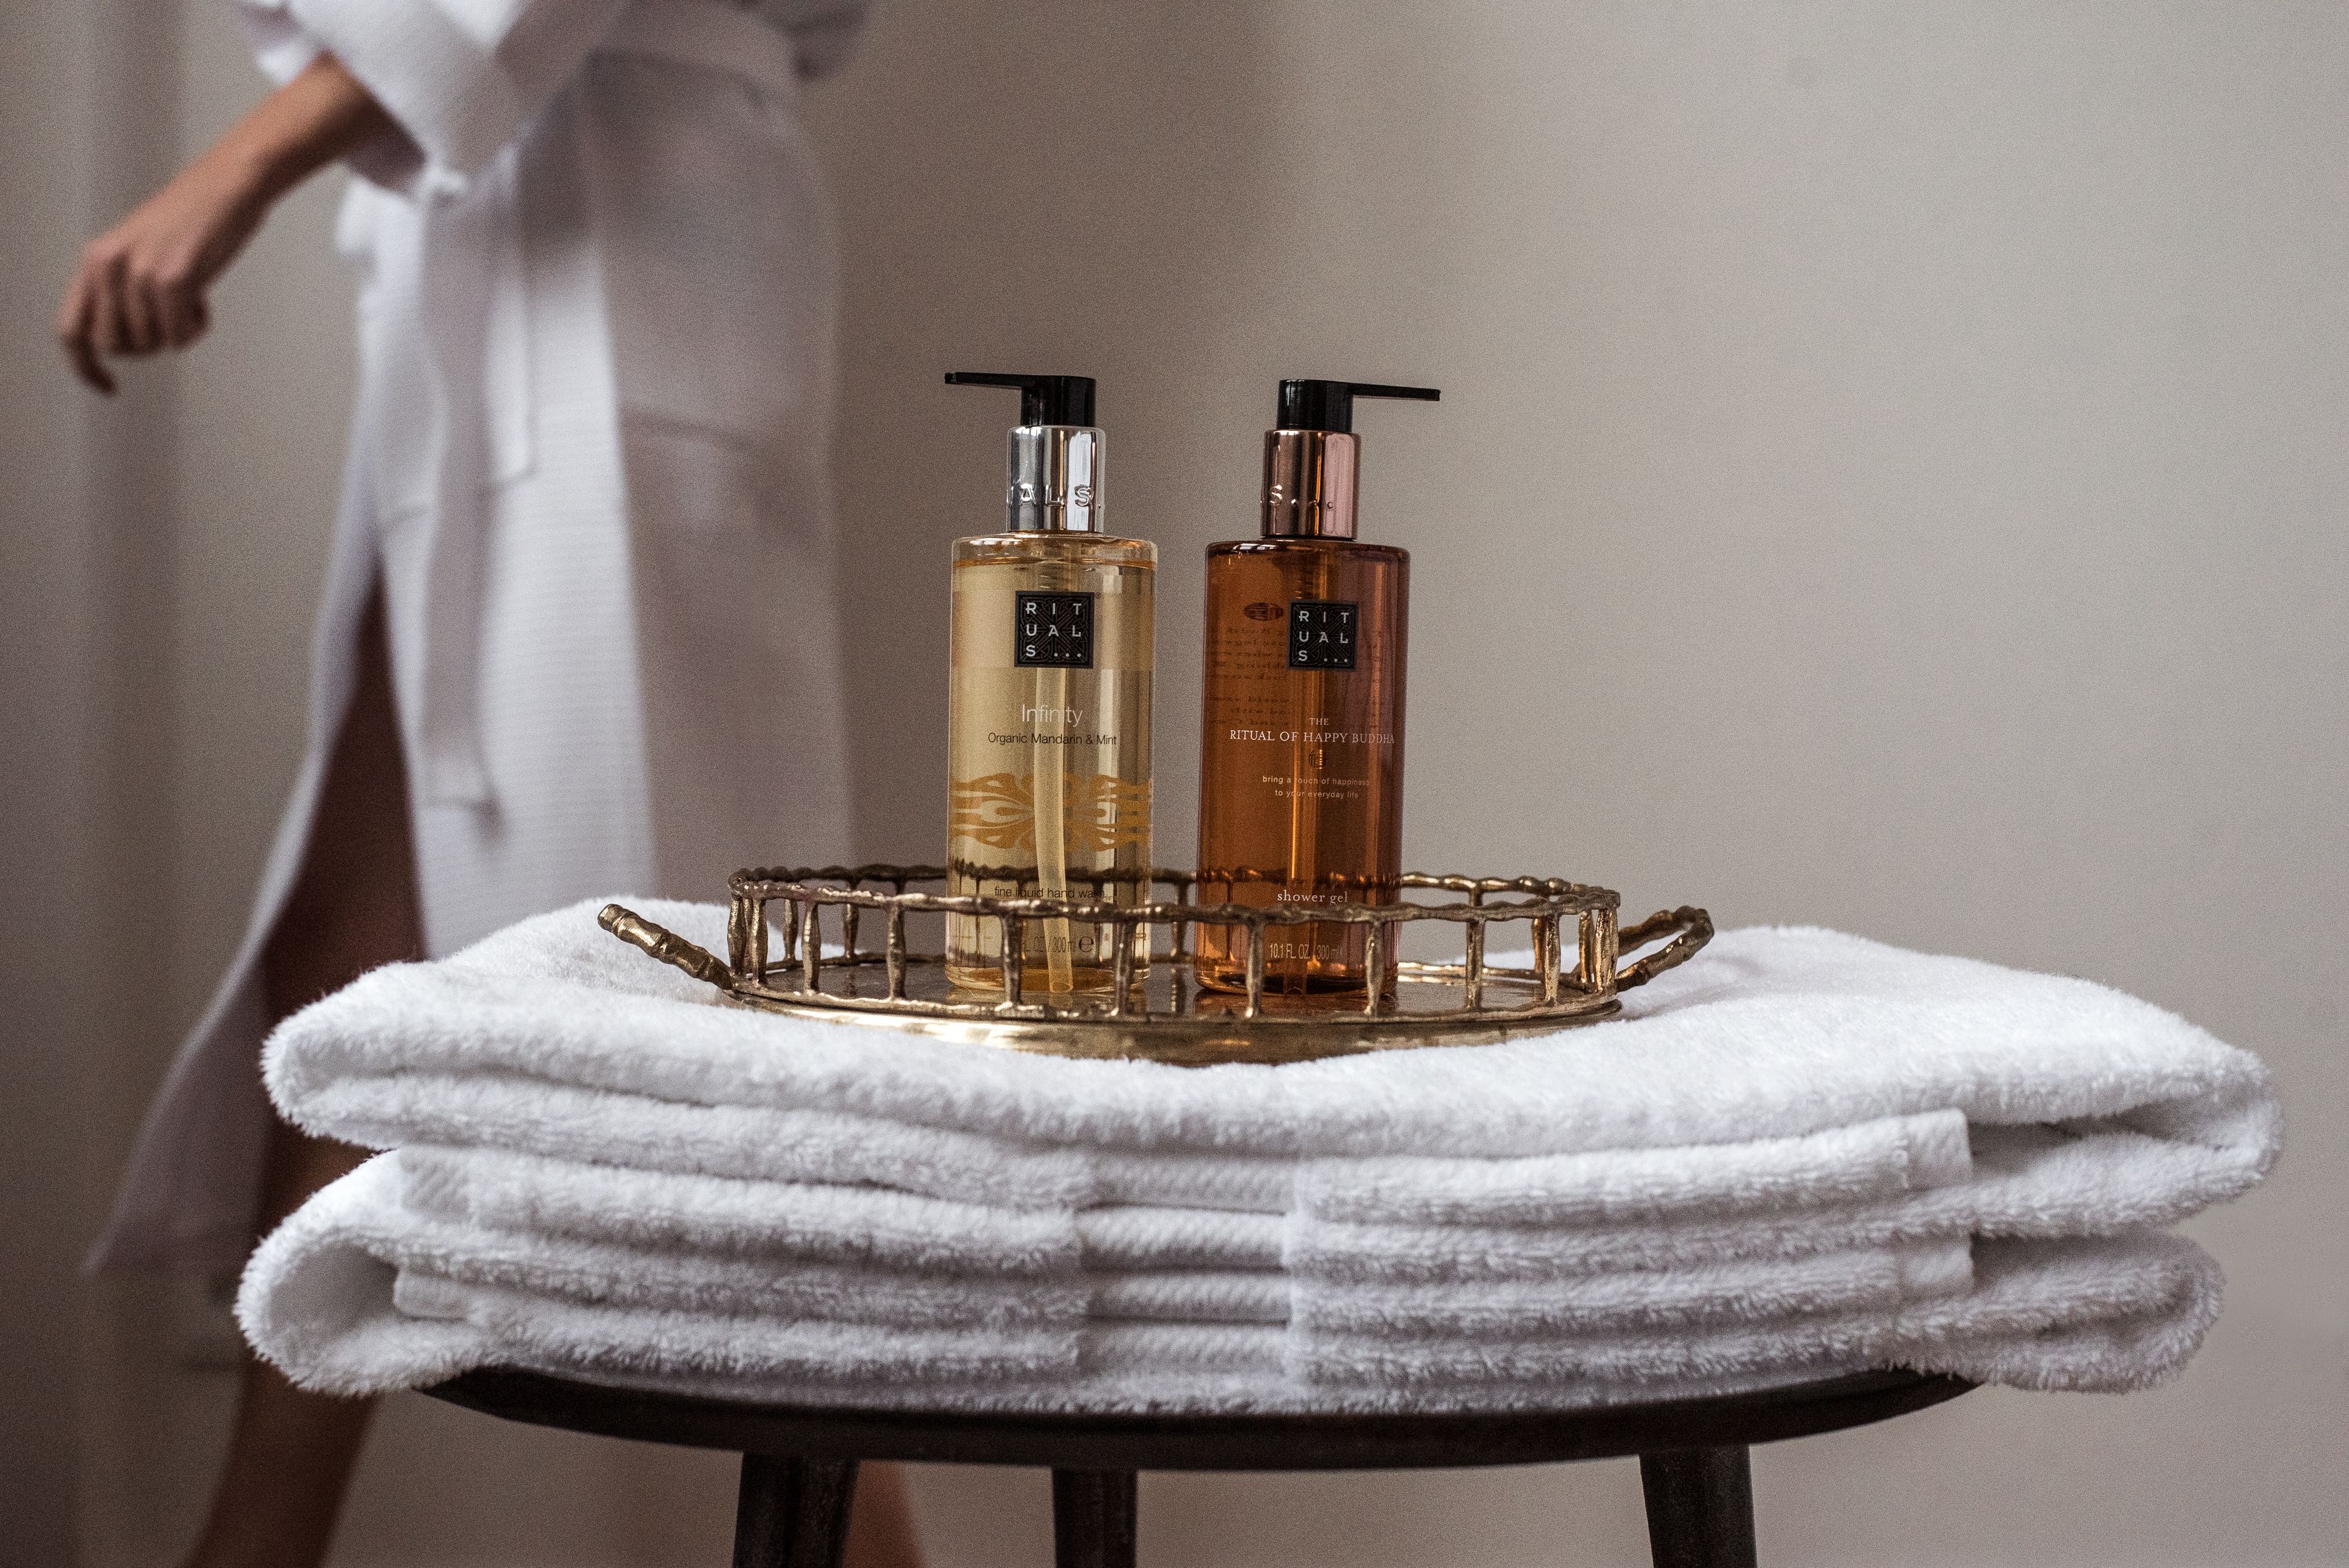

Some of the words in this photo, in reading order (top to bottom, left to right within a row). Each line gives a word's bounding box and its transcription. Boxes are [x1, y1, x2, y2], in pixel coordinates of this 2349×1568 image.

[1025, 602, 1082, 615] RIT
[1299, 611, 1349, 623] RIT
[1026, 624, 1082, 638] UAL
[1299, 631, 1349, 644] UAL
[1022, 704, 1083, 727] Infinty
[988, 732, 1027, 745] Organic
[1031, 733, 1083, 745] Mandarin
[1085, 734, 1093, 745] &
[1096, 734, 1117, 745] Mint
[1230, 729, 1275, 741] RITUAL
[1280, 731, 1299, 742] OF
[1304, 732, 1348, 743] HAPPY
[1352, 734, 1395, 744] BUDDHA
[1262, 775, 1284, 785] bring
[1321, 777, 1329, 785] of
[1332, 778, 1369, 787] happiness
[1308, 792, 1344, 800] everyday
[995, 886, 1012, 897] fine
[1047, 887, 1075, 899] hand
[1277, 890, 1326, 902] shower
[1330, 891, 1348, 905] gel
[1269, 943, 1284, 959] 10.1
